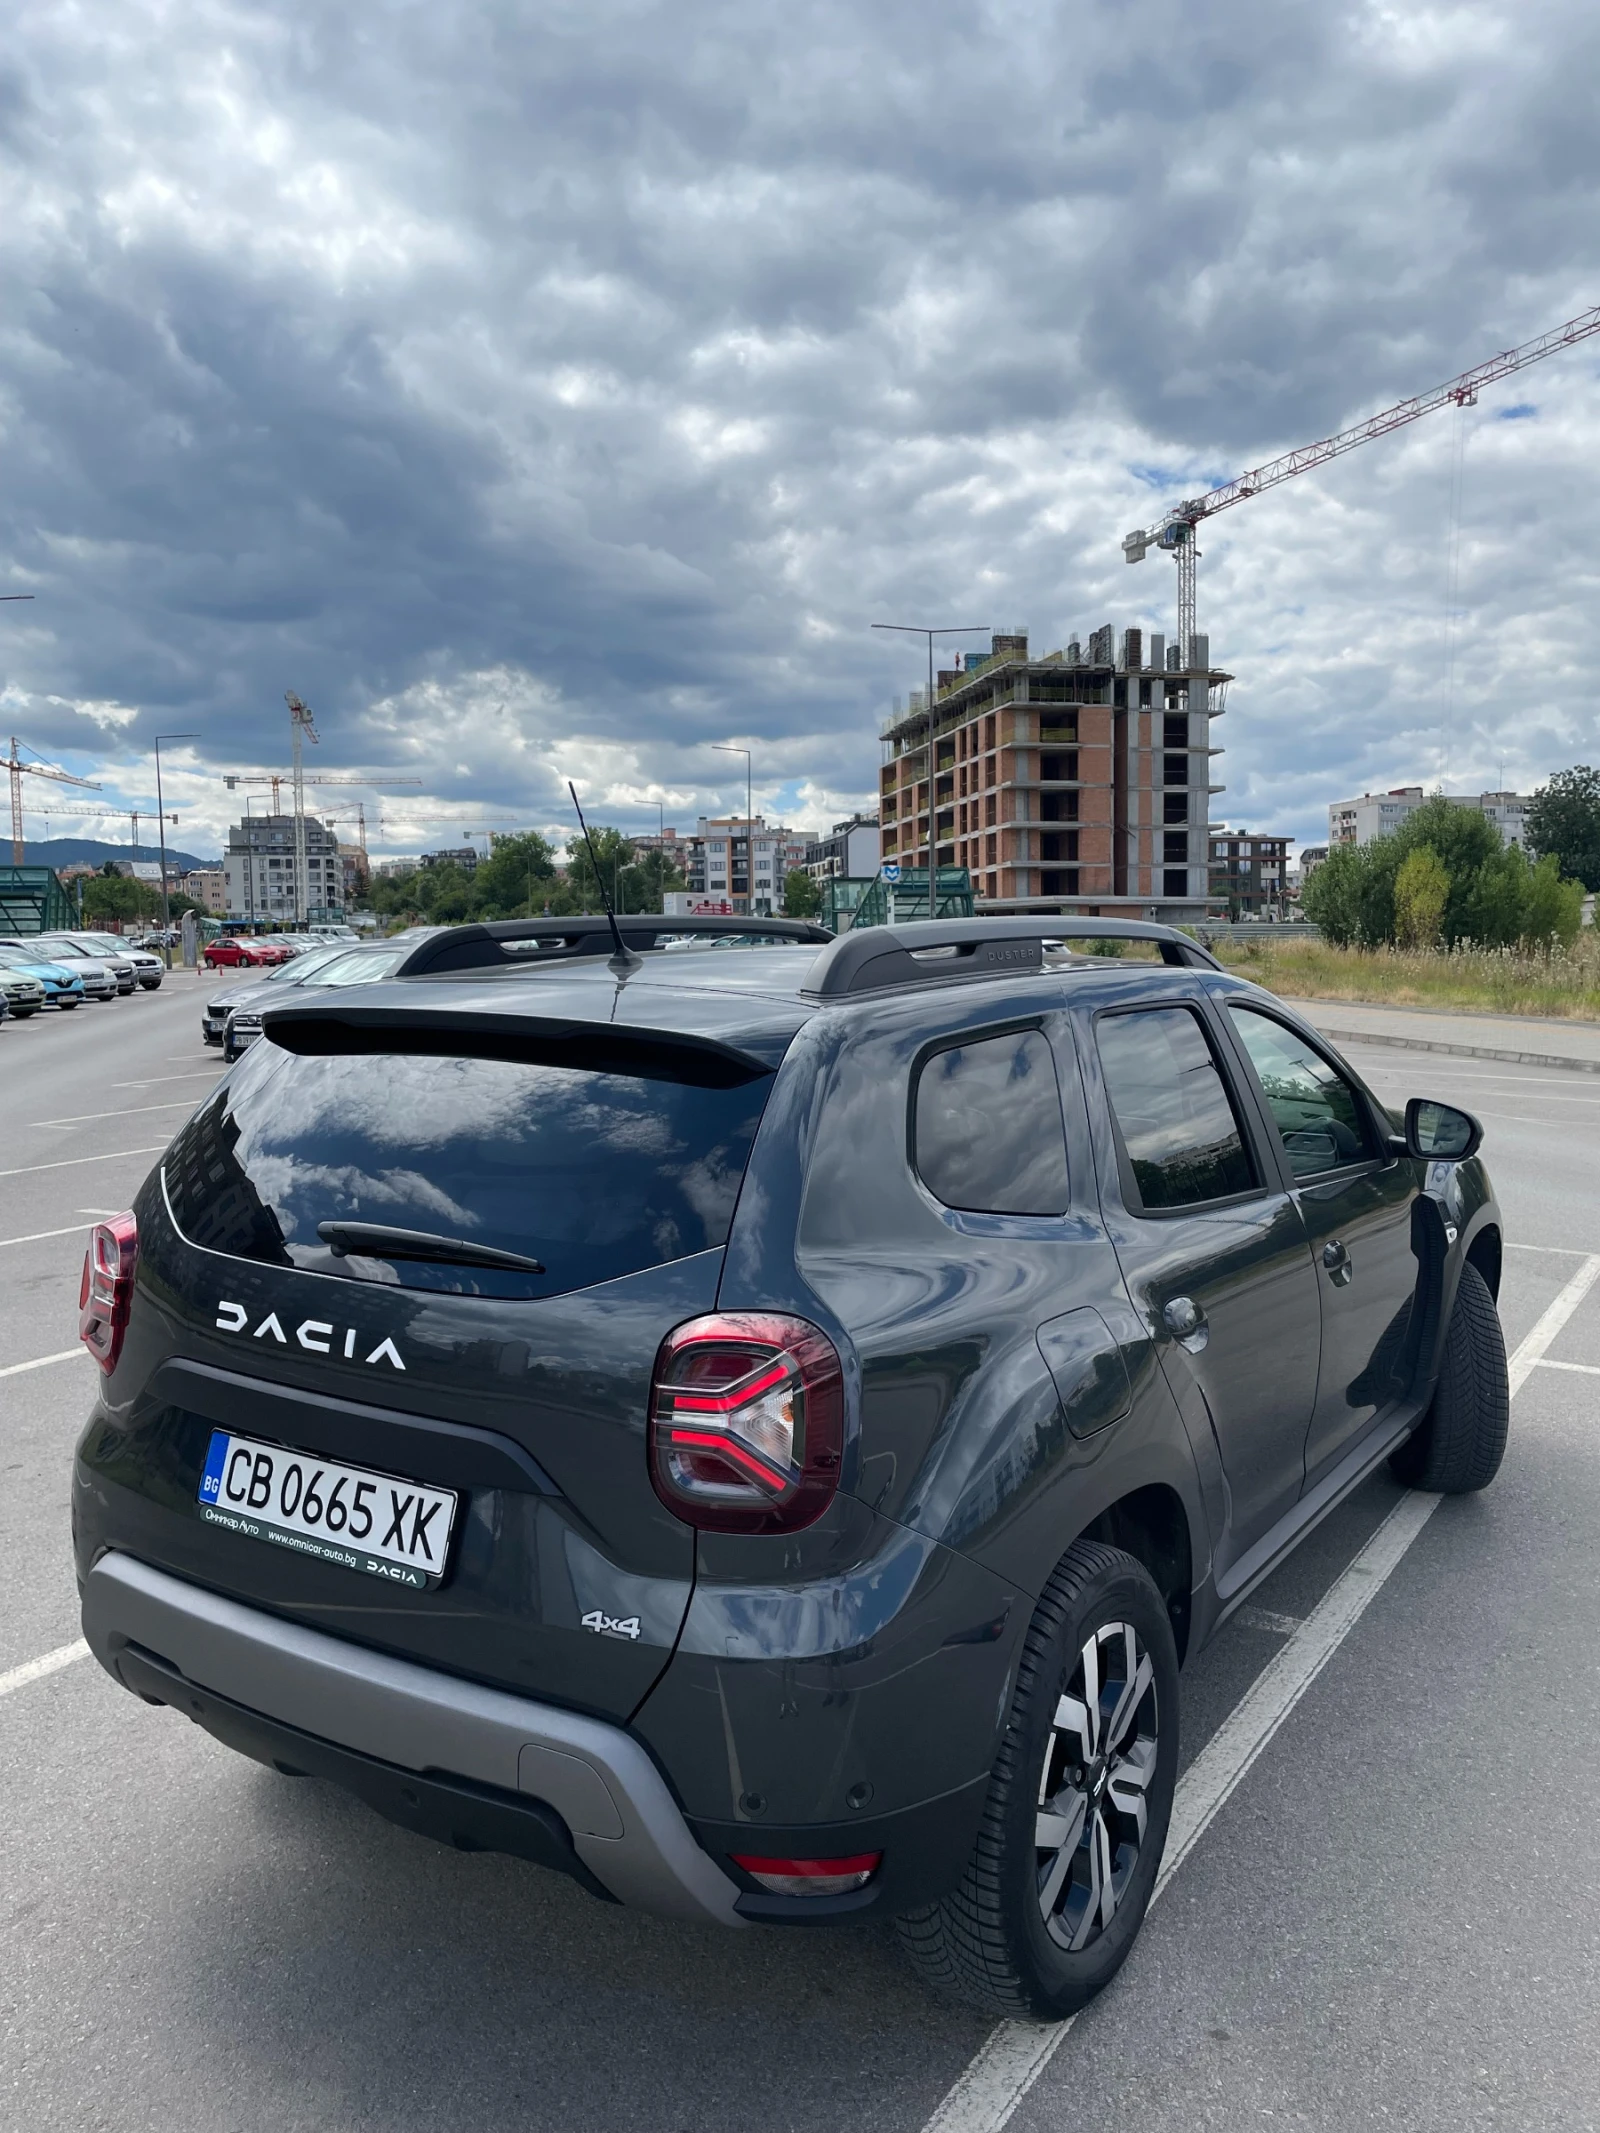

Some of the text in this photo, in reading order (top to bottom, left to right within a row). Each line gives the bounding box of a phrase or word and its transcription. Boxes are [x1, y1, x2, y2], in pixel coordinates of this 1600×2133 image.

[987, 948, 1034, 961] DUSTER
[216, 1300, 406, 1371] DACIA
[204, 1475, 220, 1494] BG
[225, 1448, 443, 1561] CB 0665 XK
[205, 1508, 260, 1535] Омникар Ауто
[268, 1530, 357, 1568] www.omnicar-auto.bg
[366, 1560, 418, 1585] DACIA
[581, 1610, 641, 1639] 4x4
